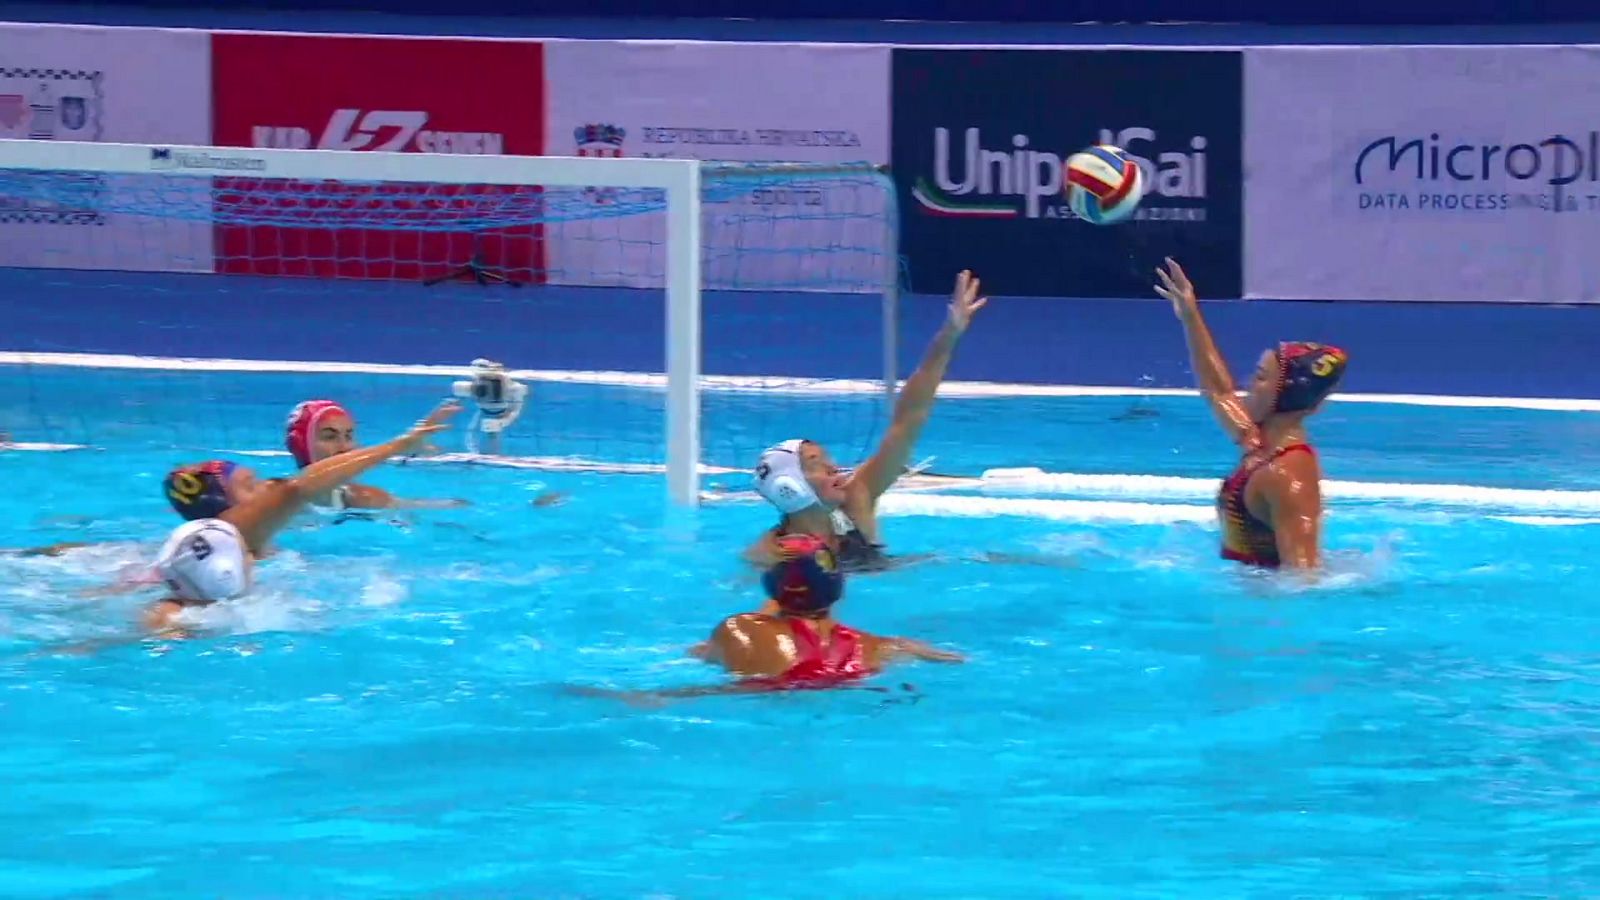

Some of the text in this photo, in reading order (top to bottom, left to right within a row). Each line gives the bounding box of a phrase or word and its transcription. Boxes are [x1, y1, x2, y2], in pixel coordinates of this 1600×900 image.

[1358, 192, 1410, 210] DATA
[1311, 353, 1338, 377] 5
[168, 472, 202, 506] 10
